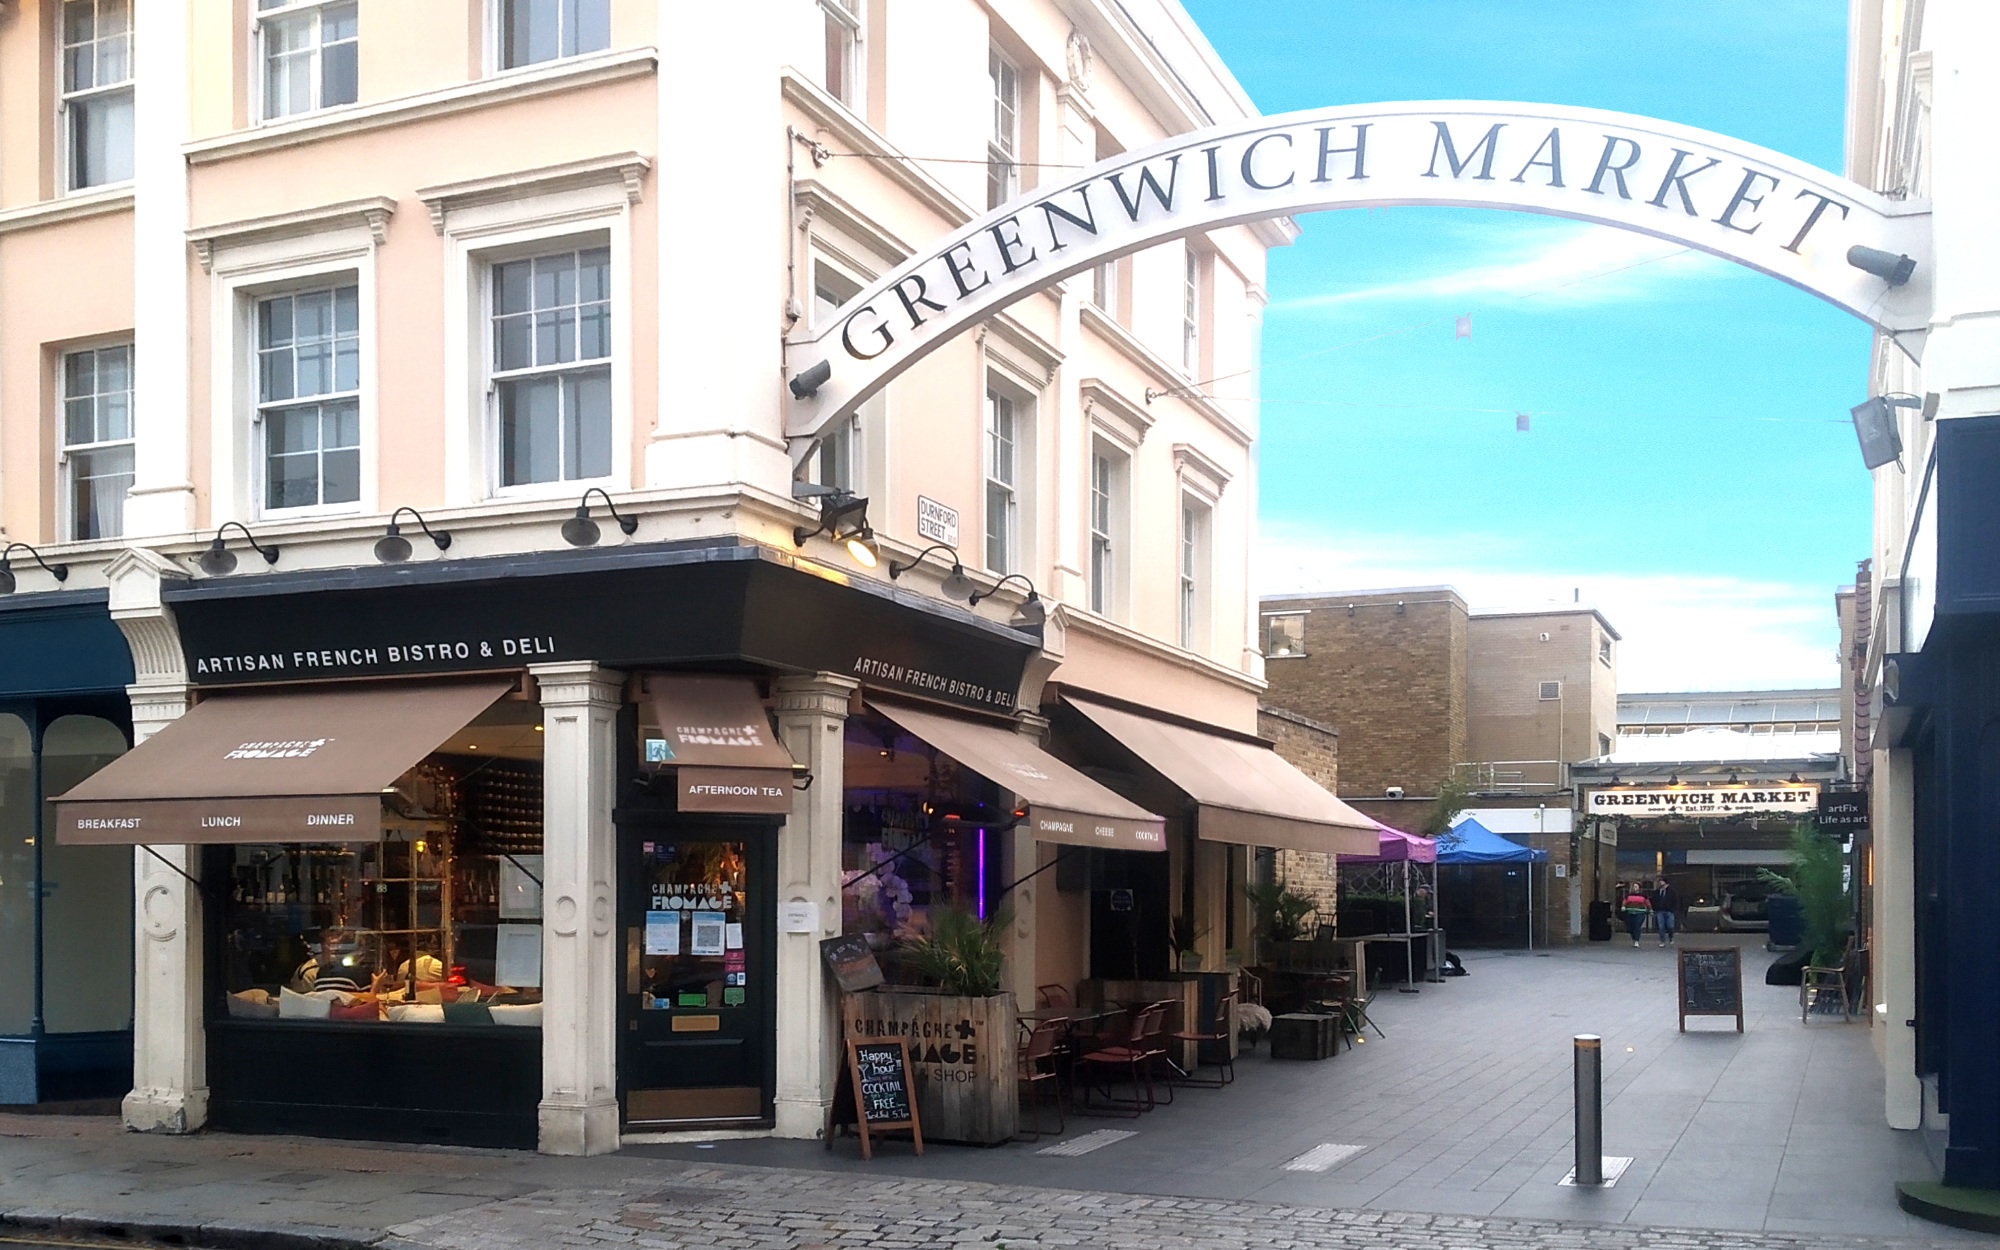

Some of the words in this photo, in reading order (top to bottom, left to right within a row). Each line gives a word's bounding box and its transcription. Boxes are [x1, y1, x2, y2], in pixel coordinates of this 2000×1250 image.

[841, 123, 1374, 360] GREENWICH
[1421, 121, 1850, 256] MARKET
[921, 500, 956, 528] DURNFORD
[921, 517, 946, 540] STREET
[197, 654, 284, 673] ARTISAN
[293, 649, 378, 667] FRENCH
[388, 642, 469, 662] BISTRO
[480, 641, 493, 657] &
[503, 636, 555, 656] DELI
[854, 657, 904, 681] ARTISAN
[905, 669, 947, 691] FRENCH
[949, 680, 984, 700] BISTRO
[986, 690, 992, 702] &
[995, 691, 1016, 708] DELI
[678, 734, 763, 746] FROMAGE
[224, 748, 317, 759] FROMAGE
[689, 785, 757, 795] AFTERNOON
[762, 787, 783, 796] TEA
[1594, 793, 1714, 805] GREENWICH
[1721, 791, 1810, 803] MARKET
[1828, 804, 1858, 812] artFix
[78, 818, 141, 829] BREAKFAST
[202, 816, 241, 827] LUNCH
[307, 814, 354, 825] DINNER
[1819, 816, 1838, 824] Life
[1040, 820, 1073, 833] CHAMPAGNE
[1095, 826, 1114, 837] CHEESE
[652, 883, 717, 894] CHAMPAGNE
[652, 896, 732, 909] FROMAGE
[855, 1019, 952, 1038] CHAMPAGNE
[859, 1049, 893, 1064] Happy
[934, 1068, 977, 1082] SHOP
[862, 1081, 902, 1094] COCKTAIL
[873, 1098, 895, 1109] FREE
